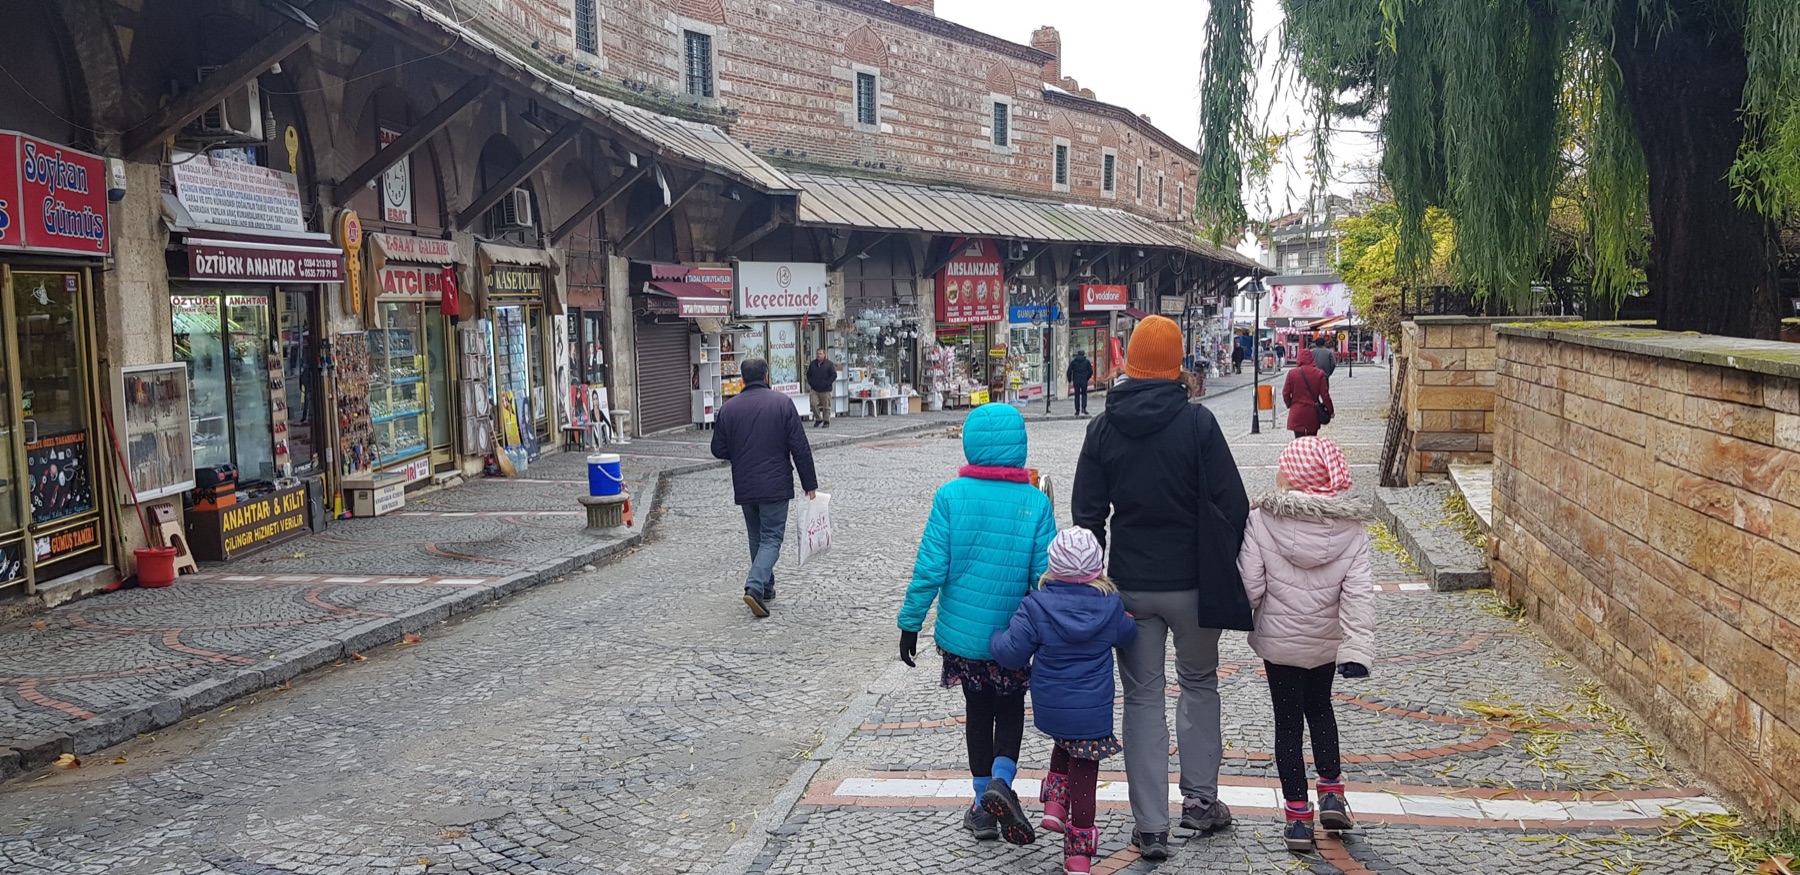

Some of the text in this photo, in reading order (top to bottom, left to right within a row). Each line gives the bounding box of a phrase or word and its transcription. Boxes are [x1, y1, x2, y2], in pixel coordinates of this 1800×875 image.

[24, 142, 88, 196] Soykan
[43, 196, 104, 248] Gümüş
[388, 208, 407, 222] ESAT
[196, 249, 295, 276] ÖZTÜRK ANAHTAR
[948, 262, 999, 276] ARSLANZADE
[425, 272, 442, 292] ESA
[230, 296, 267, 305] ANAHTAR
[745, 286, 819, 310] keçecizade
[1095, 291, 1119, 300] vodafone
[223, 490, 305, 532] ANAHTAR & KİLİT
[52, 523, 94, 553] GÜMÜŞ TAMİRİ
[224, 514, 303, 555] ÇİLİNGİR HİZMETİ VERİLİR
